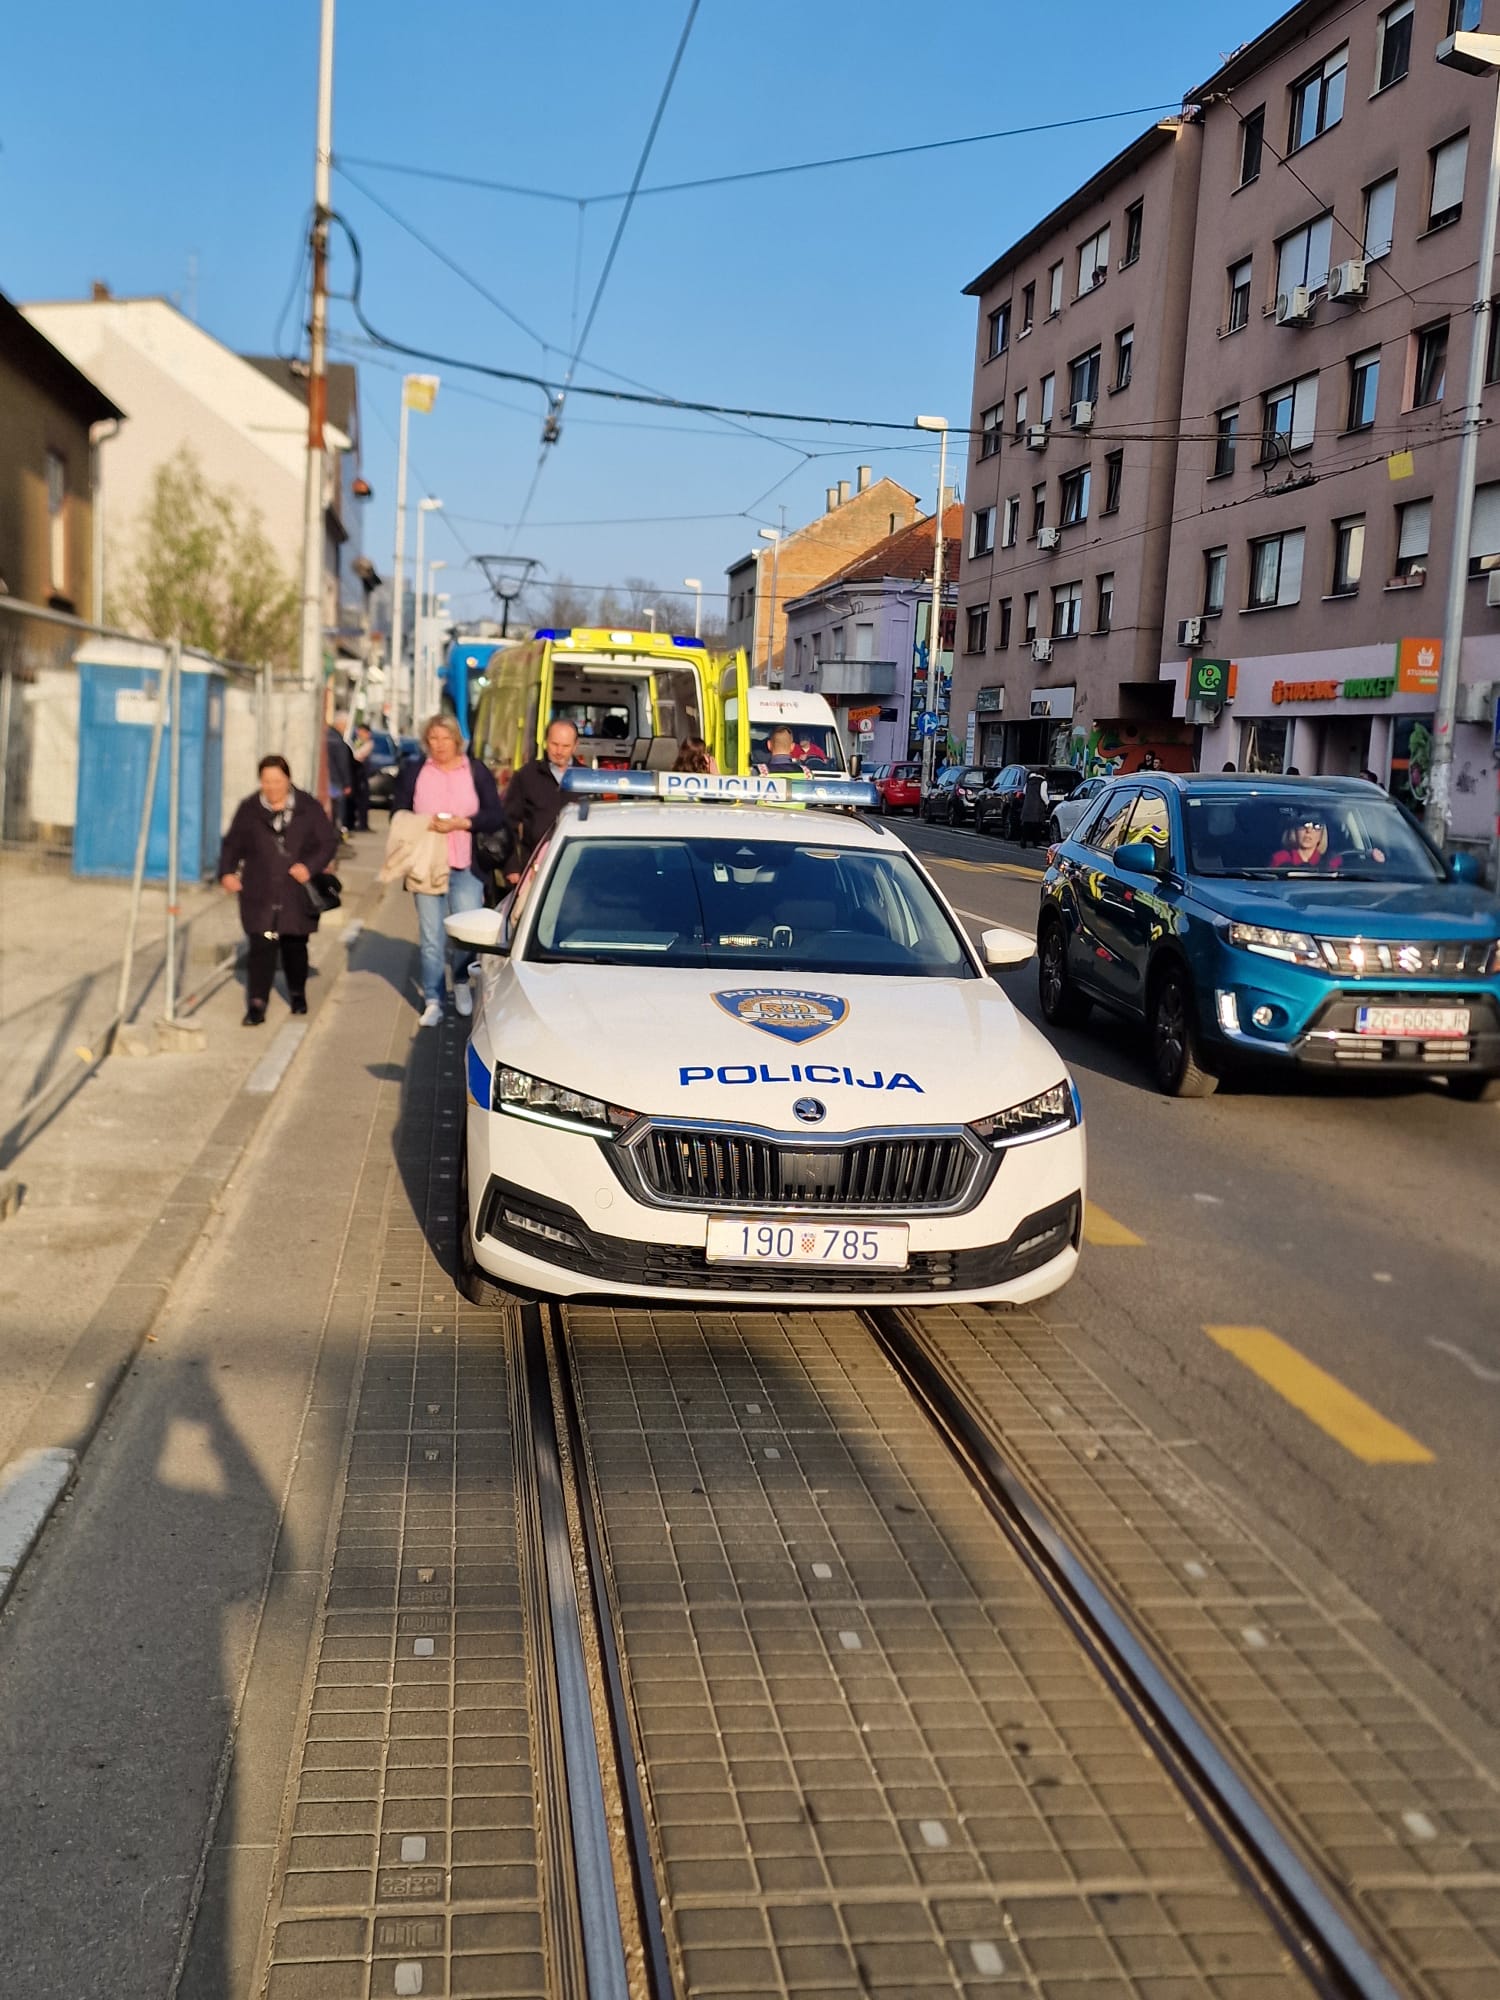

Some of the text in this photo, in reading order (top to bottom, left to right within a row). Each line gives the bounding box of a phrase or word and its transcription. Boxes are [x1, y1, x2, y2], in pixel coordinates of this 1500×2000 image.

[1201, 667, 1214, 677] TO
[1205, 678, 1221, 687] GO
[1344, 677, 1395, 699] MARKET
[667, 775, 780, 799] POLICIJA
[720, 989, 840, 1003] POLICIJA
[1370, 1009, 1392, 1028] ZG
[678, 1064, 926, 1094] POLICIJA
[742, 1226, 879, 1260] 190 785
